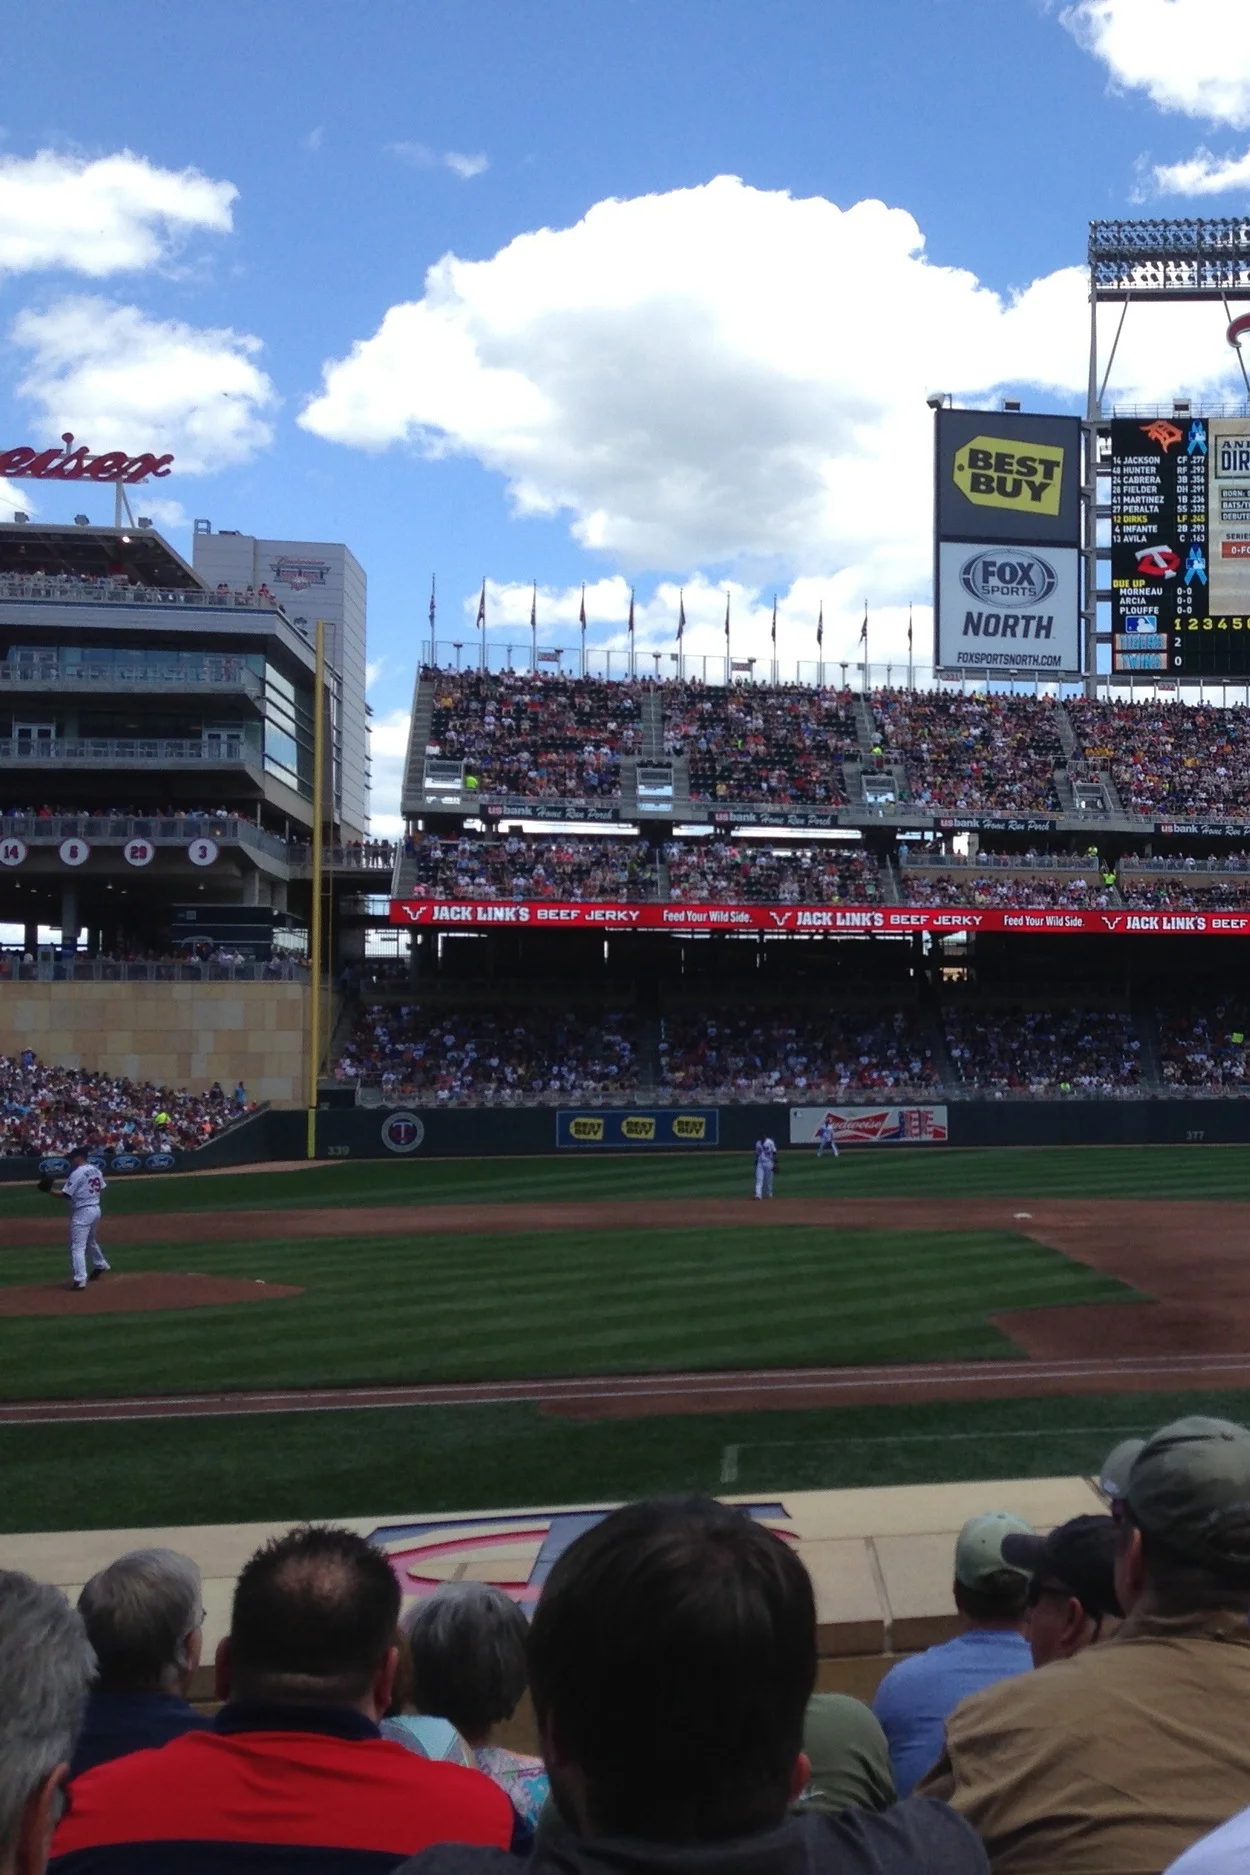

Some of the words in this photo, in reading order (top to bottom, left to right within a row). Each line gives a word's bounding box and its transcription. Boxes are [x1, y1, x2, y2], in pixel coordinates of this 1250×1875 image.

[968, 448, 1061, 480] BEST
[970, 472, 1051, 502] BUY
[982, 560, 1035, 586] FOX
[981, 585, 1037, 597] SPORTS
[1113, 580, 1130, 588] DUE
[962, 611, 1054, 639] NORTH
[957, 651, 1061, 667] FOXSPORTSNORTH.COM
[3, 845, 19, 859] 14
[199, 845, 207, 859] 3
[432, 906, 472, 920] JACK
[477, 906, 530, 922] LINK'S
[536, 910, 582, 920] BEEF
[585, 910, 640, 921] JERKY
[663, 910, 684, 922] Feed
[686, 911, 708, 923] Your
[709, 911, 729, 923] Wild
[730, 911, 752, 923] Side.
[796, 912, 833, 926] JACK
[836, 912, 884, 926] LINK'S
[889, 914, 930, 925] BEEF
[933, 915, 983, 925] JERKY
[1126, 916, 1159, 929] JACK
[1163, 916, 1206, 930] LINK'S
[1211, 919, 1247, 929] BEEF
